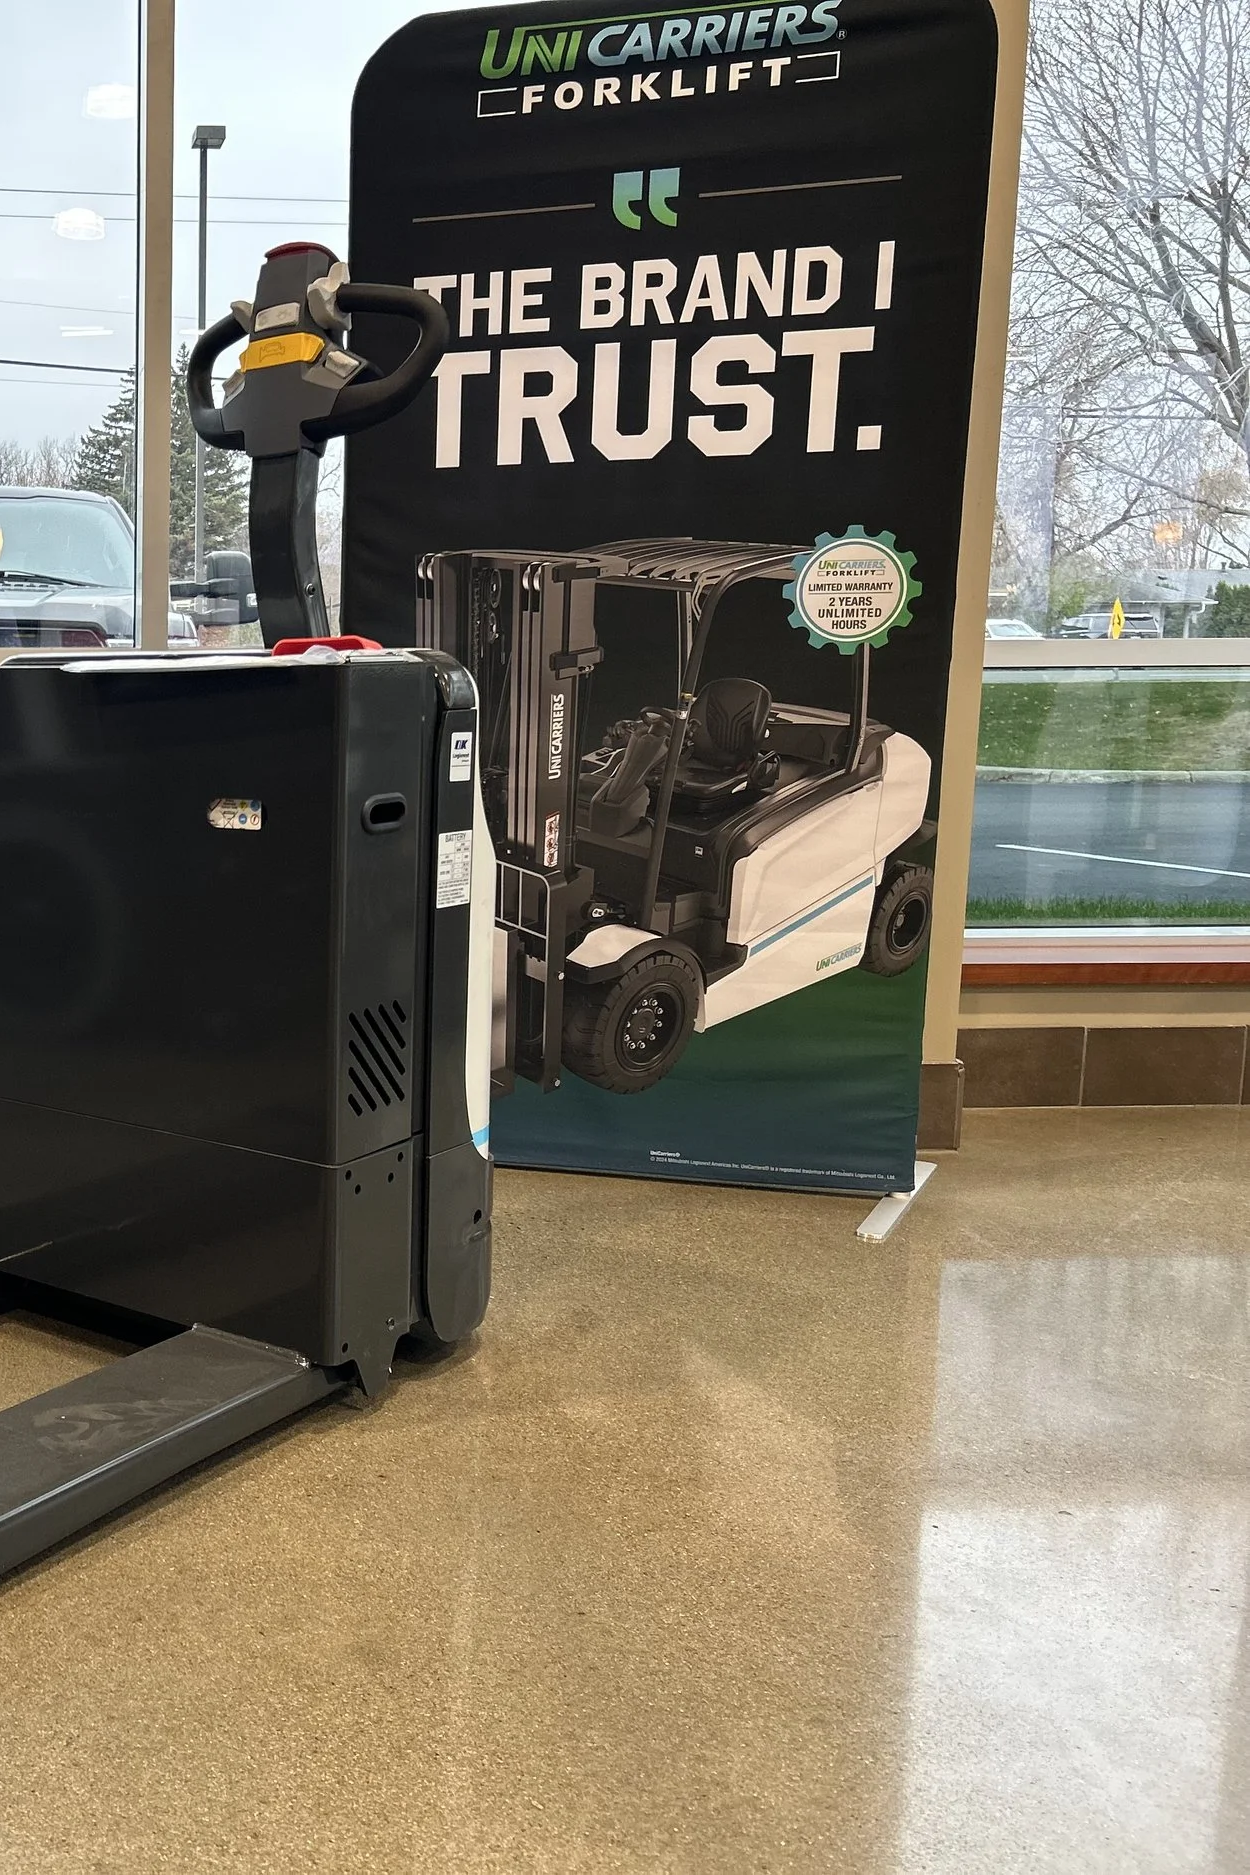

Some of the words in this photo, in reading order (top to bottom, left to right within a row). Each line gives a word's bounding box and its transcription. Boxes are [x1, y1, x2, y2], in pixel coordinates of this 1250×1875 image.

[522, 57, 791, 114] FORKLIFT
[413, 266, 552, 338] THE
[579, 245, 844, 330] BRAND
[874, 240, 896, 310] I
[430, 325, 883, 469] TRUST.
[826, 569, 876, 577] FORKLIFT
[808, 583, 843, 592] LIMITED
[844, 582, 894, 591] WARRANTY
[829, 597, 836, 607] 2
[838, 596, 873, 607] YEARS
[818, 608, 882, 619] UNLIMITED
[831, 620, 867, 630] HOURS
[548, 693, 565, 780] UNICARRIERS
[445, 833, 467, 843] BATTERY
